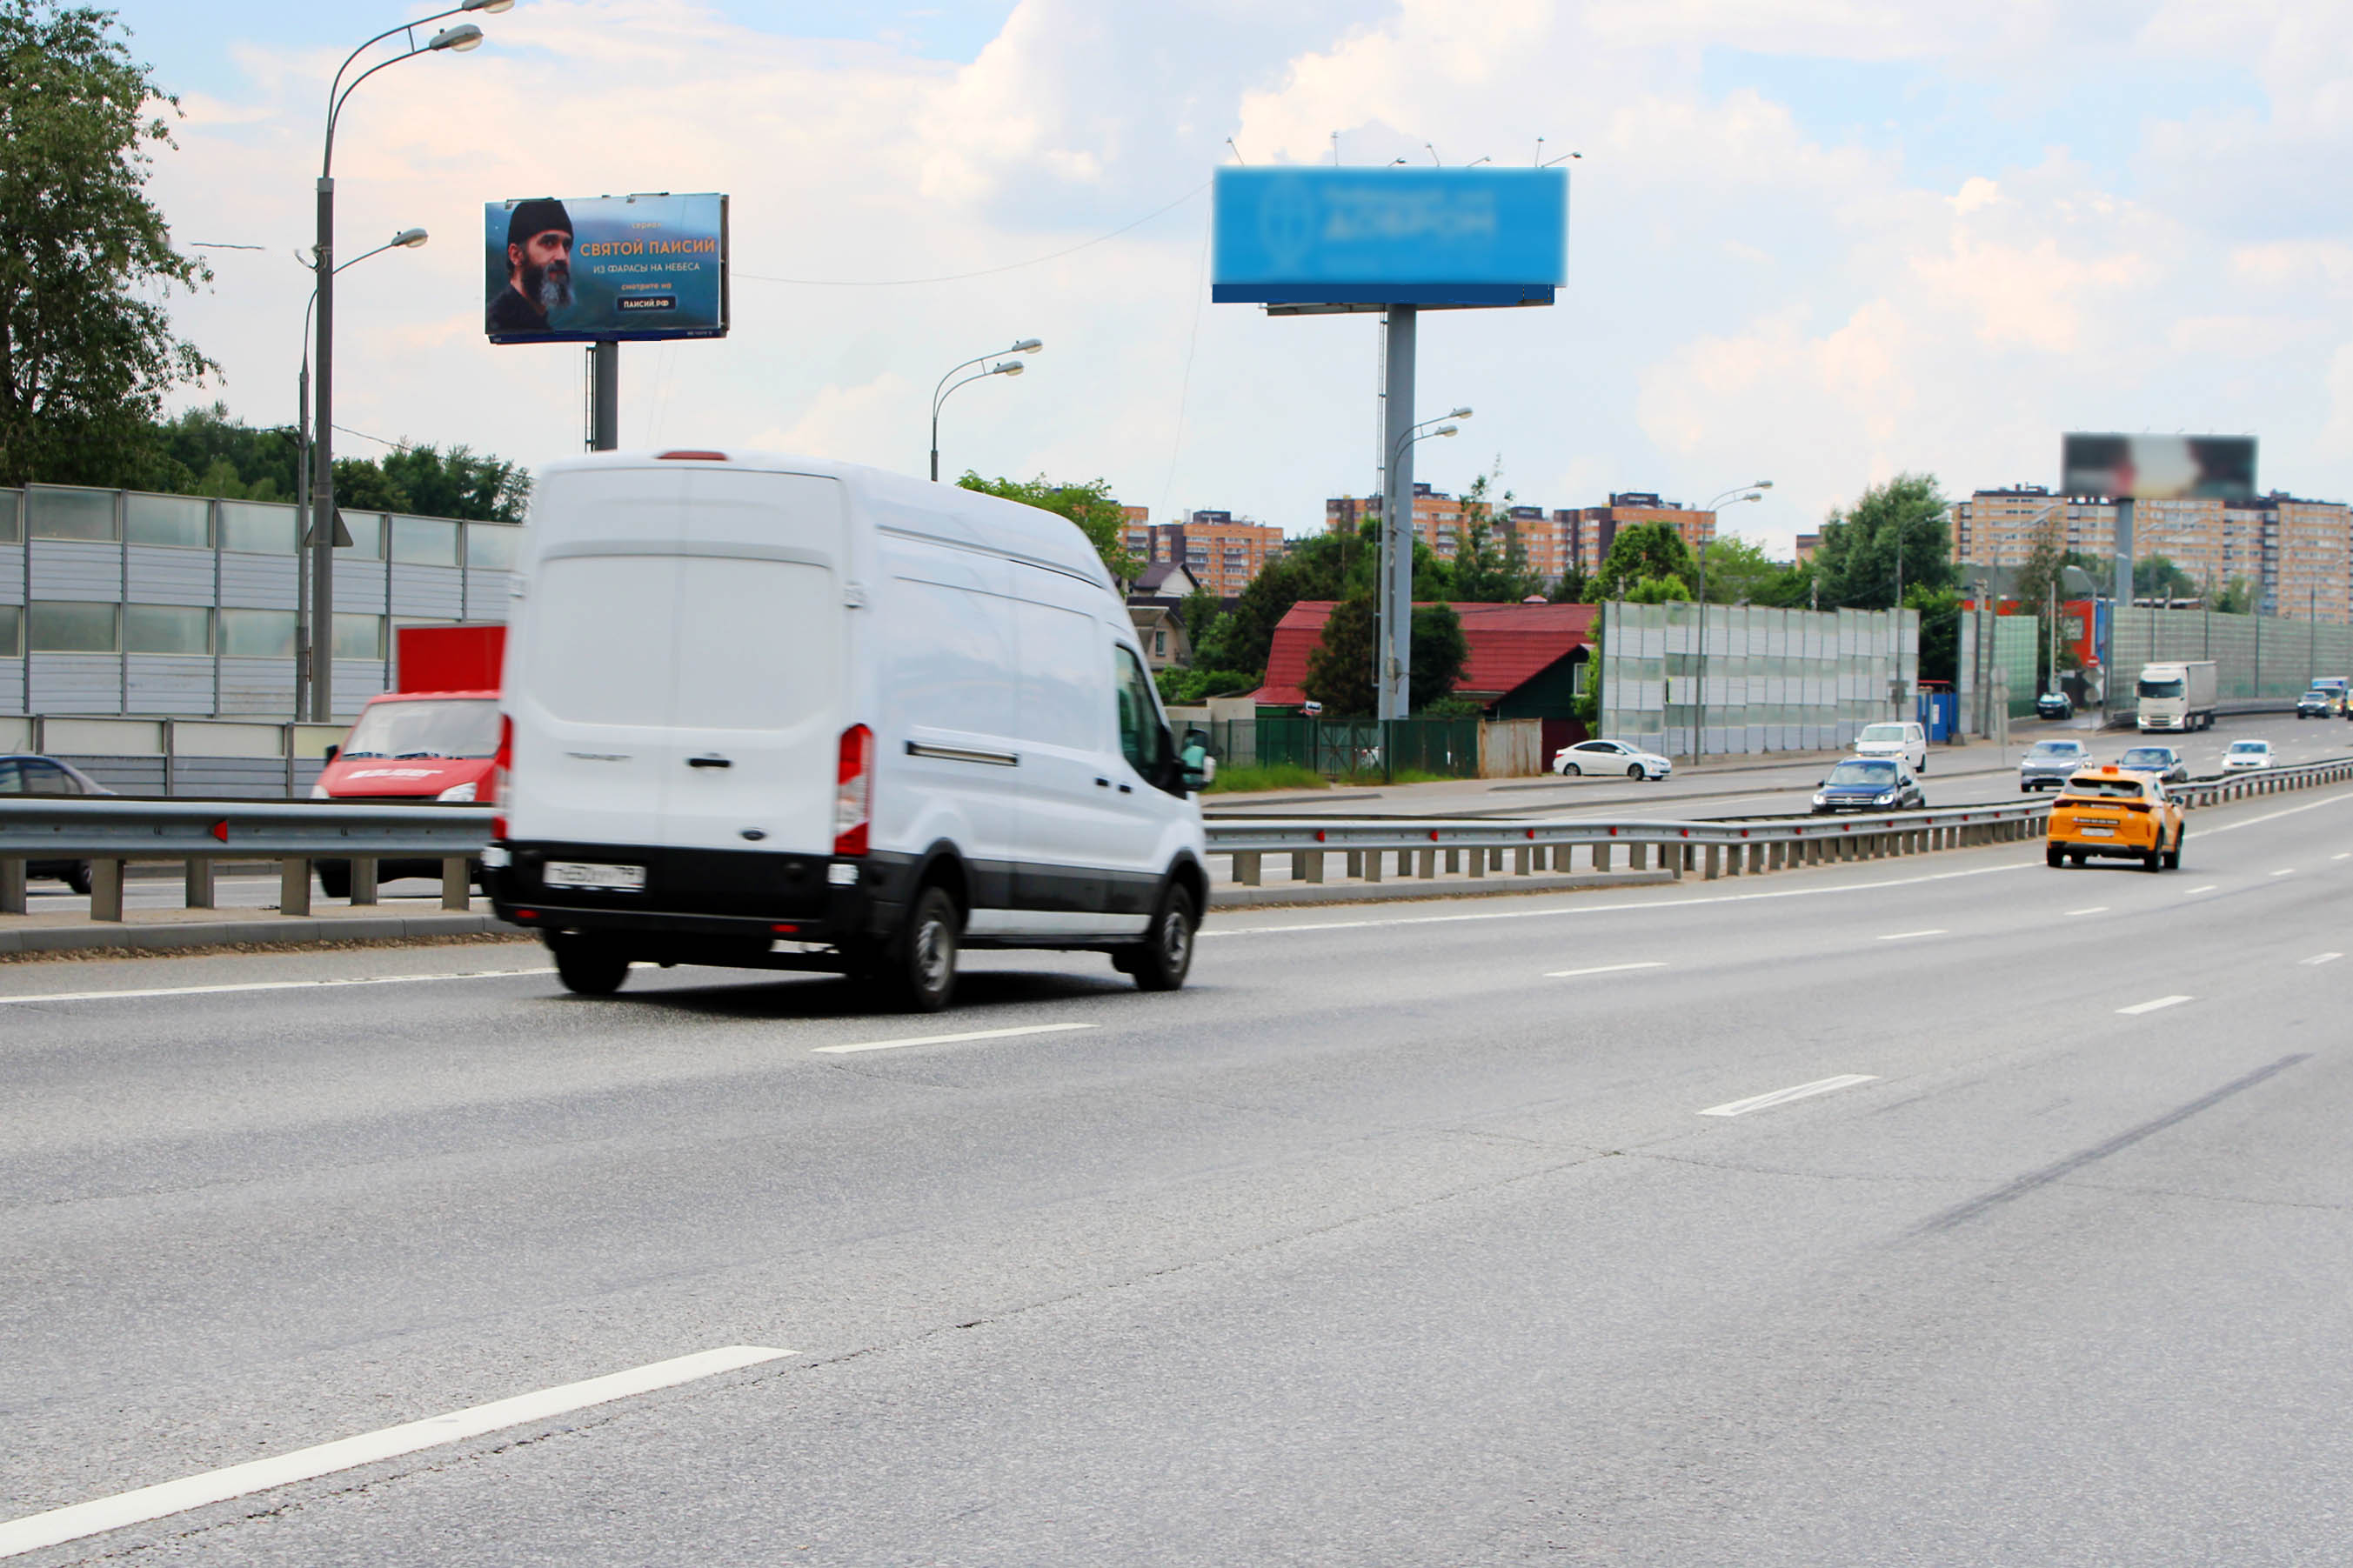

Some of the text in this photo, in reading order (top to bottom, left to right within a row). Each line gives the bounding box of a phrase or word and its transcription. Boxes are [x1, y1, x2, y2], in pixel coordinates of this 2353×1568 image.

[579, 237, 716, 257] СВЯТОЙ ПАИСИЙ
[593, 265, 605, 274] ИЗ
[607, 264, 648, 273] ФАРАСЫ
[665, 262, 700, 271] НЕБЕСА
[623, 298, 669, 309] ПАИСИЙ.РФ
